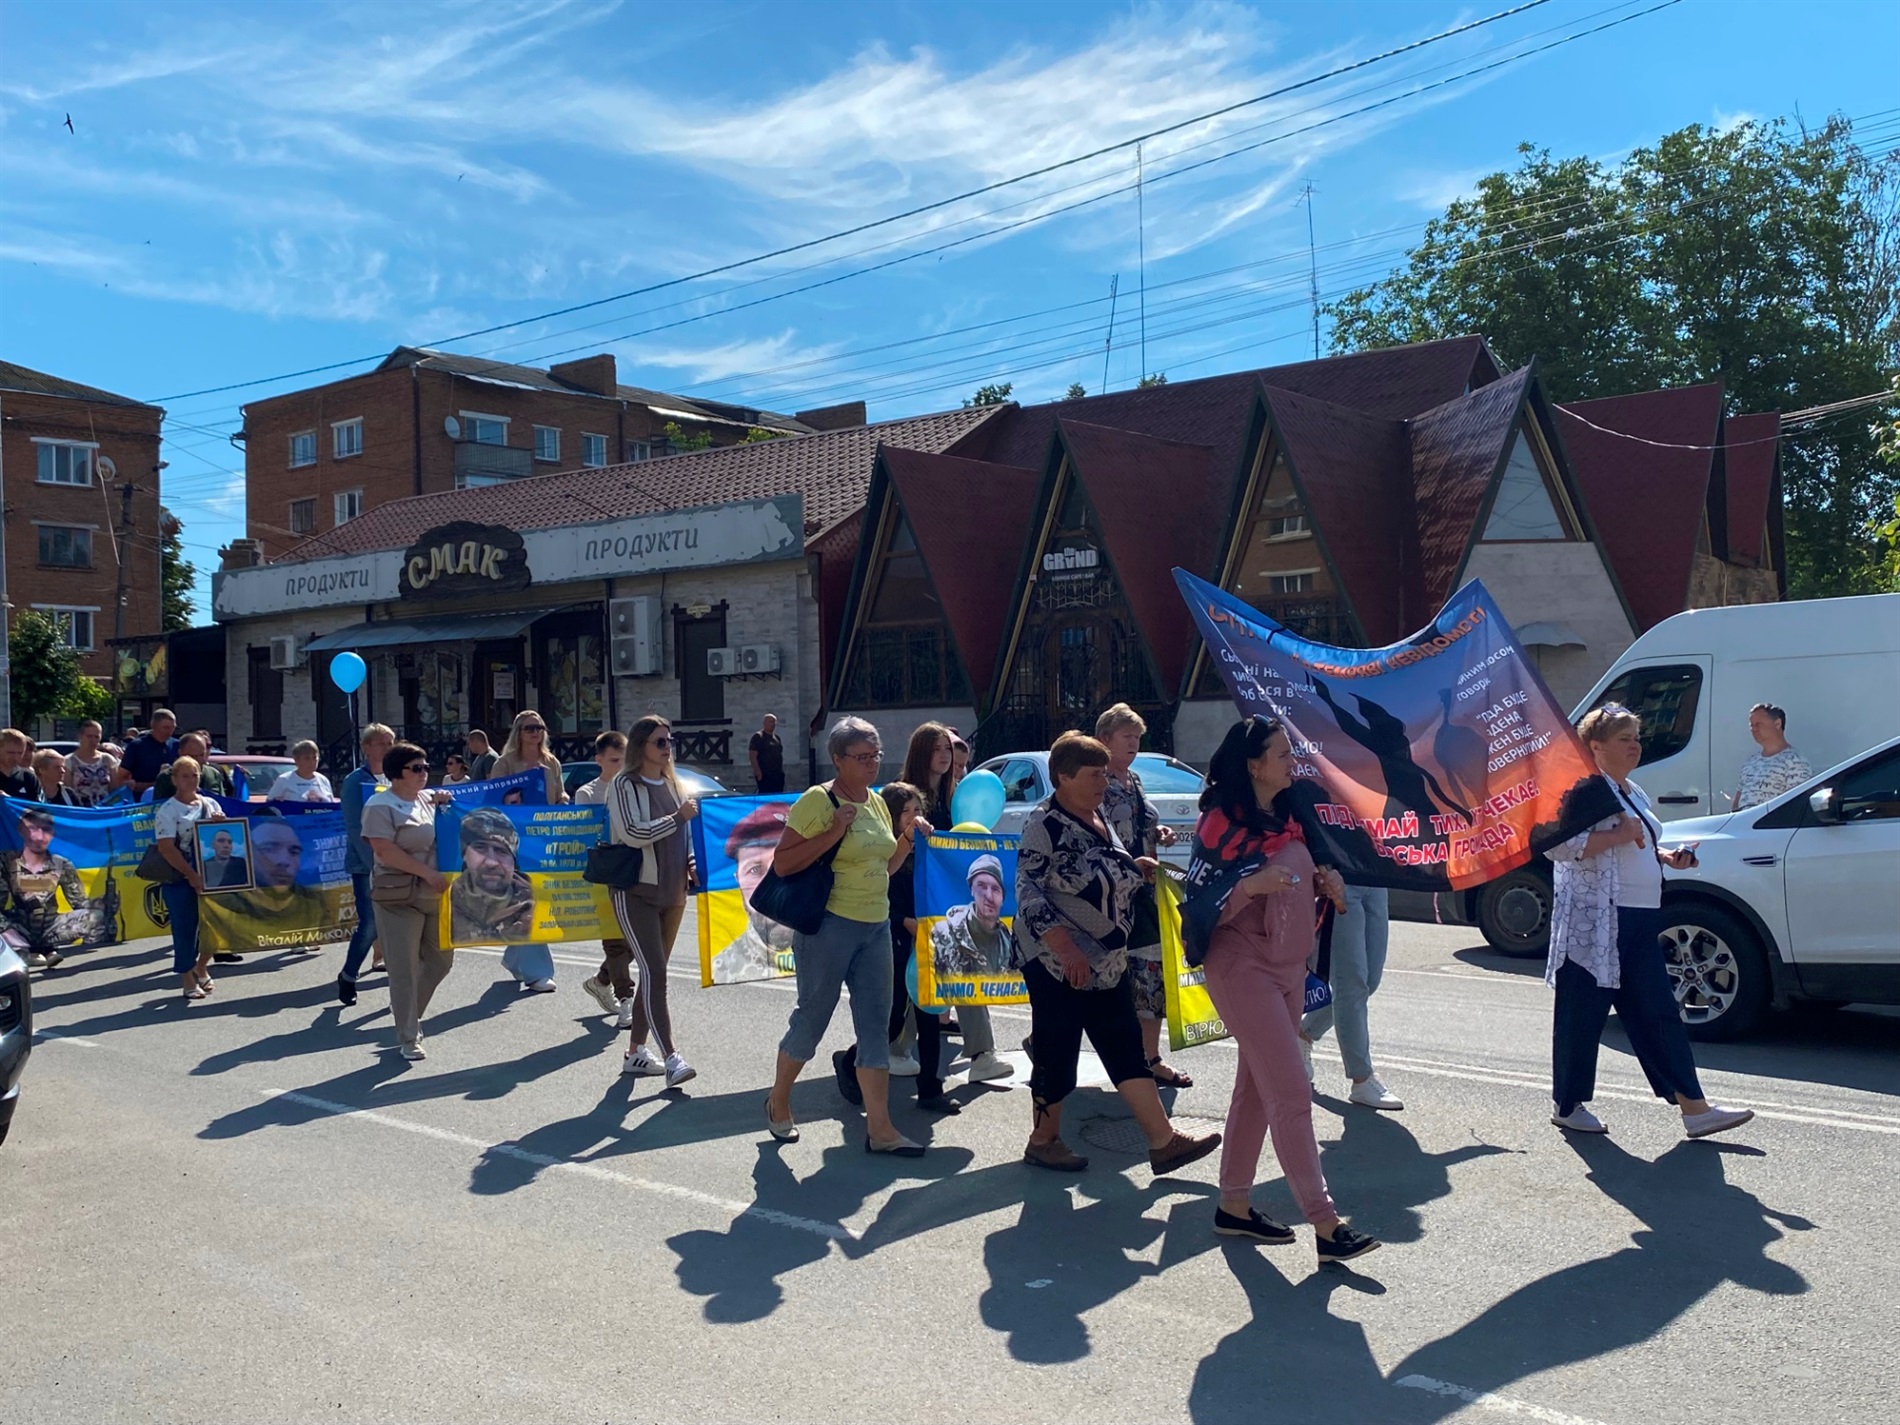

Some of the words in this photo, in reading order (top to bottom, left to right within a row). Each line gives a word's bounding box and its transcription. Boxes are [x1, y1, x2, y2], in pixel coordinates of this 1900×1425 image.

[585, 527, 698, 560] ПРОДУКТИ
[408, 541, 508, 589] СМАК
[286, 569, 369, 595] ПРОДУКТИ
[483, 775, 530, 791] напрямок
[257, 931, 304, 947] Віталій
[1185, 1019, 1228, 1042] ВІРЮ,
